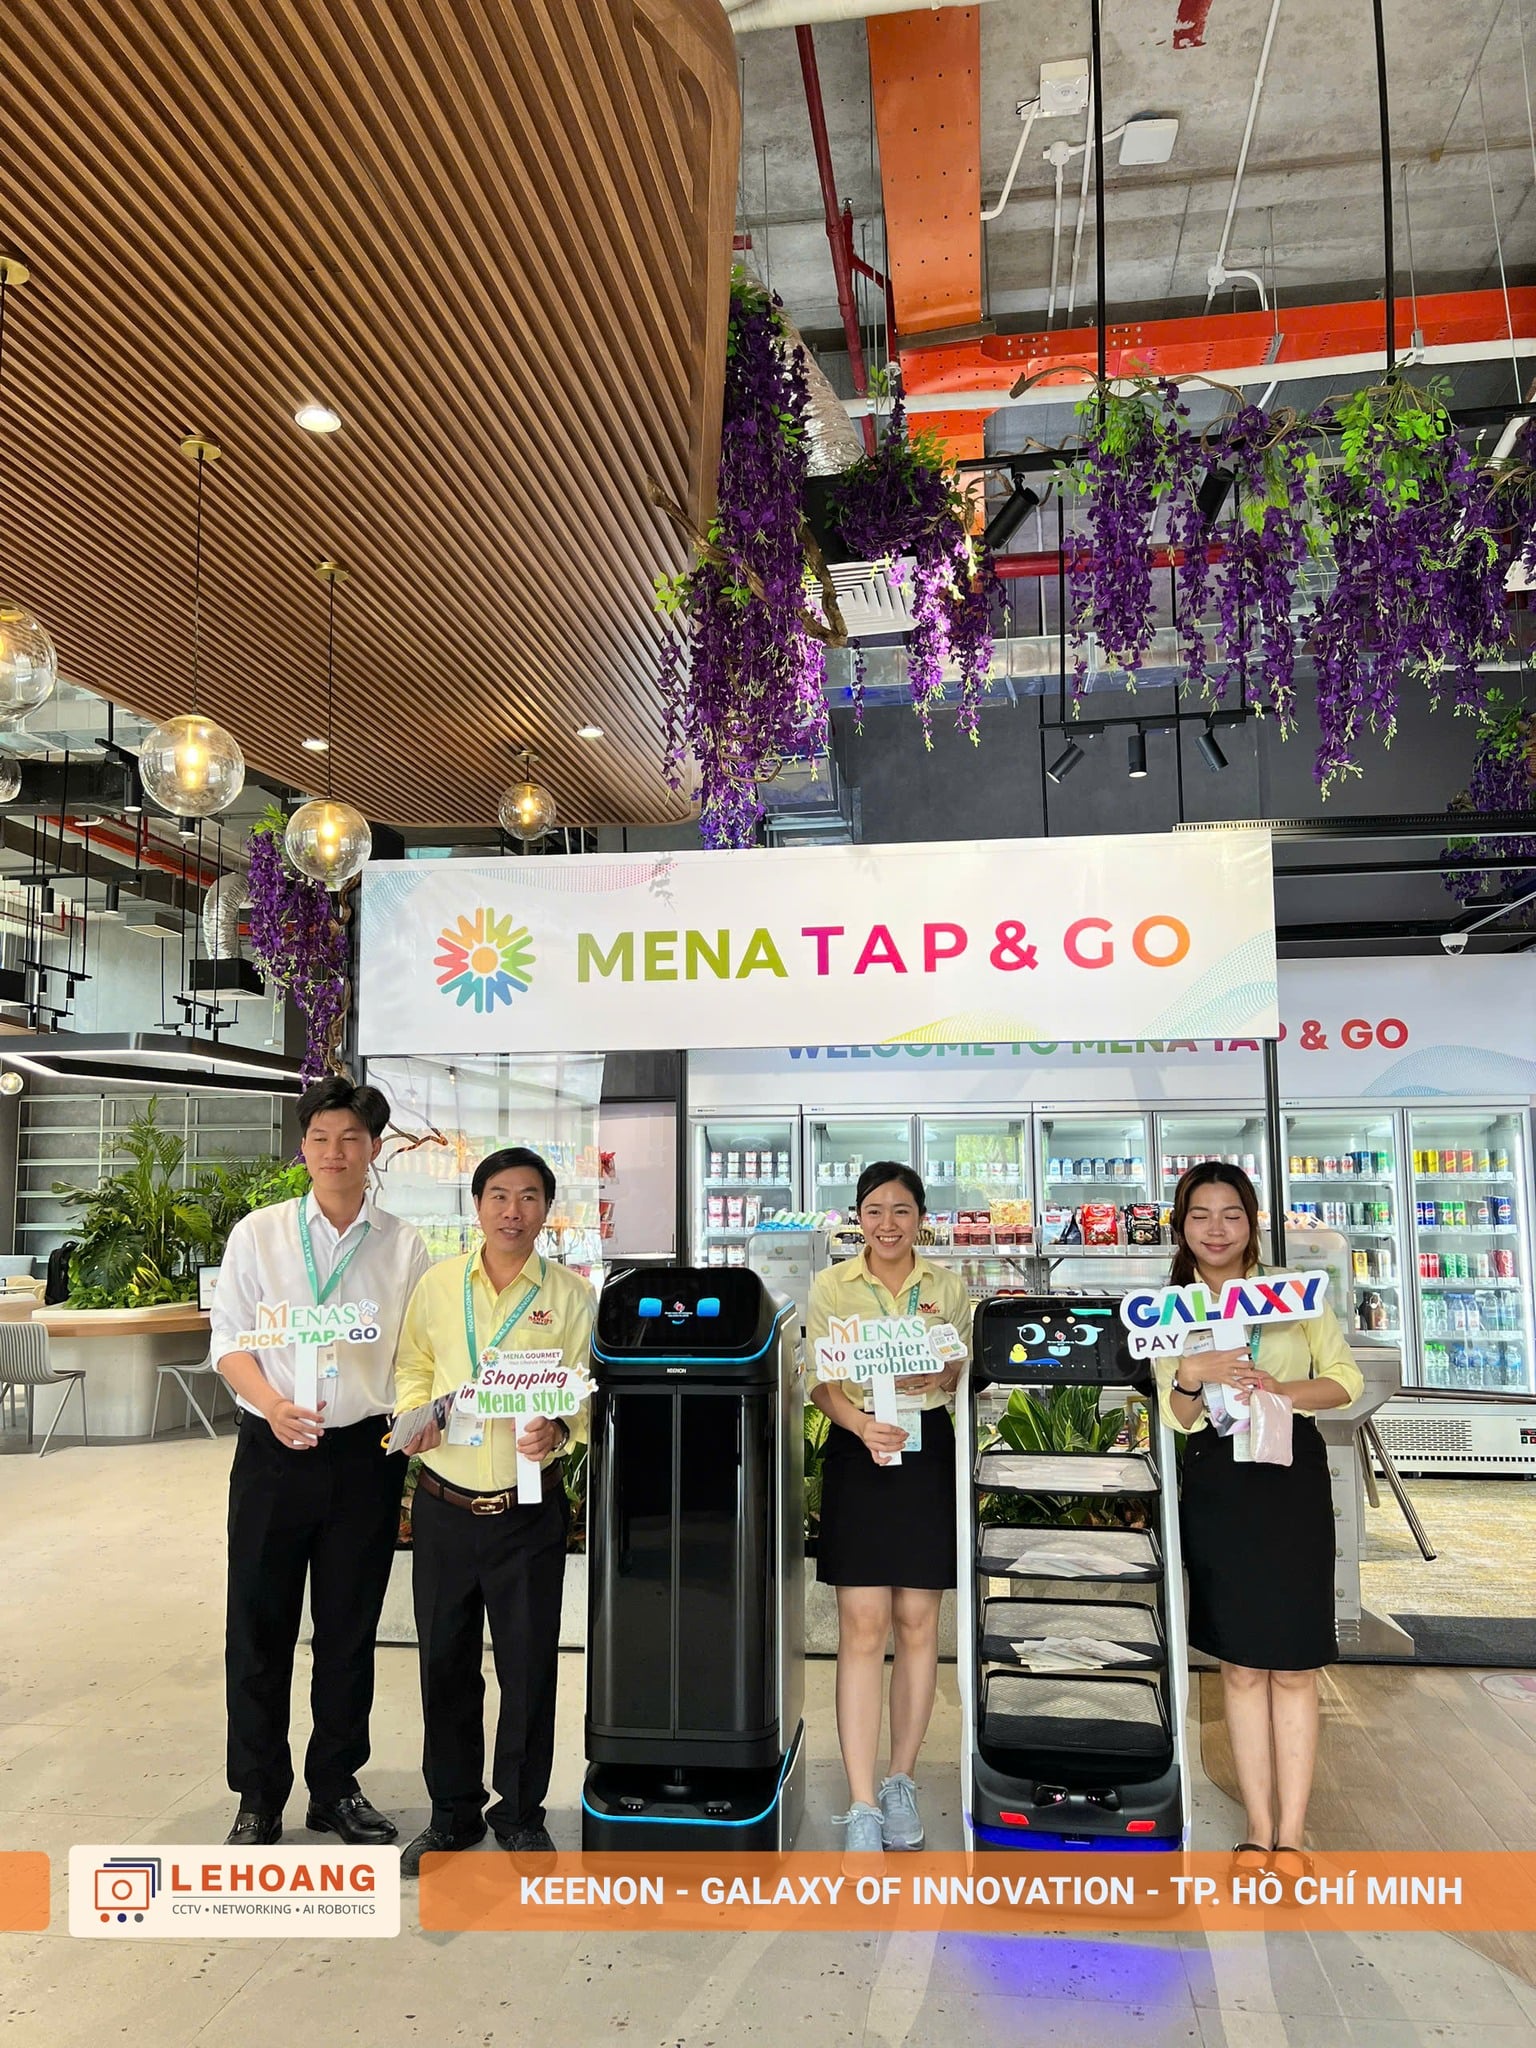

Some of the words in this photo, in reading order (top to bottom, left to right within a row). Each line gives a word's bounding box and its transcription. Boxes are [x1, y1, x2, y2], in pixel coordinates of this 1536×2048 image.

[579, 927, 787, 981] MENA
[802, 923, 967, 976] TAP
[990, 920, 1038, 971] &
[1064, 916, 1190, 969] GO
[1301, 1020, 1328, 1050] &
[1341, 1018, 1409, 1050] GO
[258, 1303, 355, 1329] MENAS
[1128, 1278, 1321, 1329] GALAXY
[239, 1333, 284, 1347] PICK
[298, 1330, 335, 1344] TAP
[349, 1327, 378, 1341] GO
[830, 1319, 925, 1345] MENAS
[1135, 1334, 1179, 1352] PAY
[525, 1351, 561, 1359] GOURMET
[820, 1347, 846, 1363] No
[482, 1368, 568, 1390] Shopping
[822, 1364, 847, 1379] No
[855, 1357, 938, 1381] problem
[460, 1385, 476, 1400] in
[478, 1391, 526, 1414] Mena
[532, 1388, 575, 1415] style
